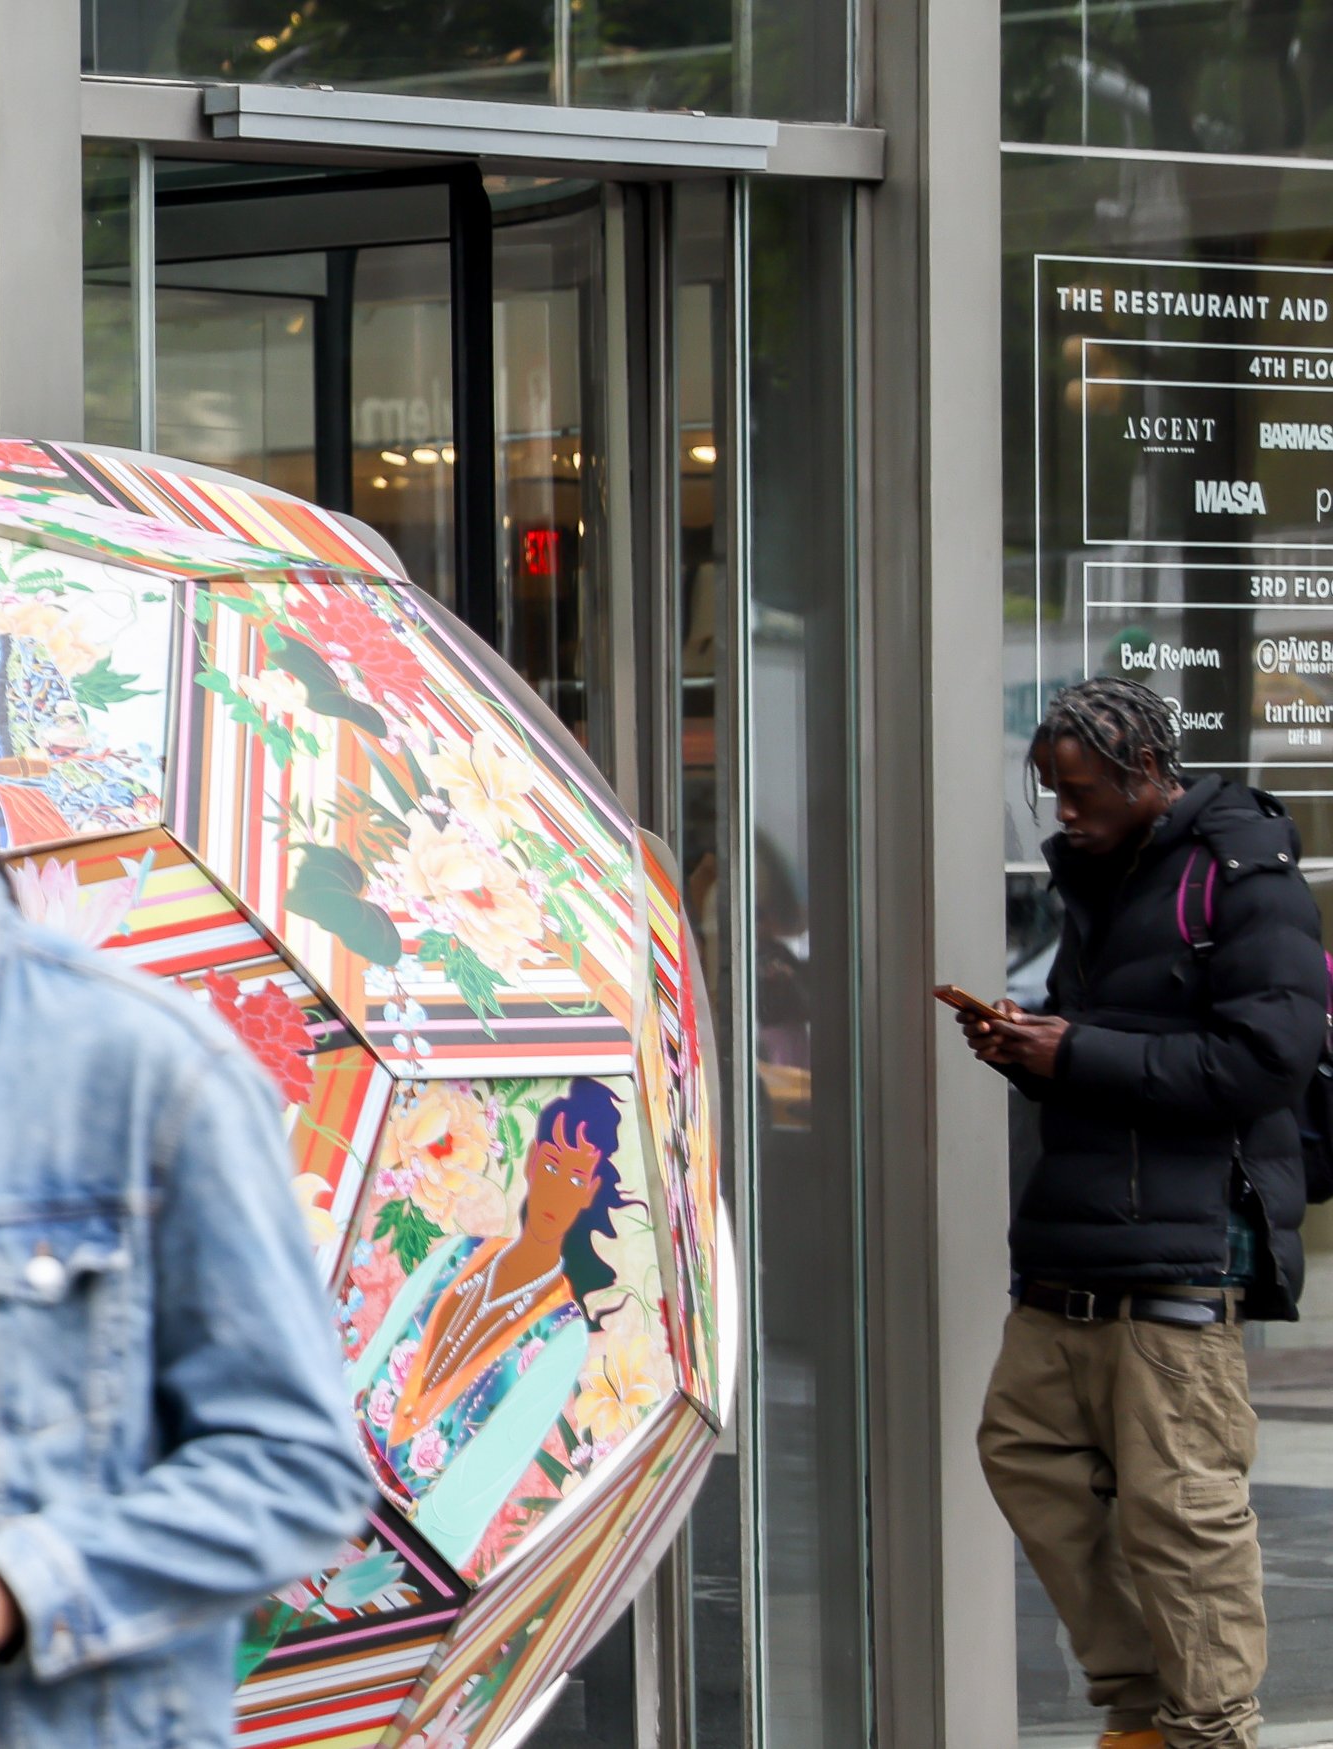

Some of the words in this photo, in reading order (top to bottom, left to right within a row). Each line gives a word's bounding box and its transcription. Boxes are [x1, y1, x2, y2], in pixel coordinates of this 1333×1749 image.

[1057, 287, 1103, 312] THE
[1114, 290, 1270, 319] RESTAURANT
[1280, 298, 1328, 322] AND
[1249, 356, 1285, 378] 4TH
[1123, 416, 1216, 442] ASCENT
[1259, 422, 1333, 451] BARMAS
[1195, 480, 1267, 515] MASA
[1250, 576, 1287, 598] 3RD
[1121, 642, 1157, 671] Bad
[1160, 644, 1221, 671] Roman
[1278, 662, 1290, 674] BY
[1183, 712, 1224, 730] SHACK
[1265, 699, 1333, 723] tartiner
